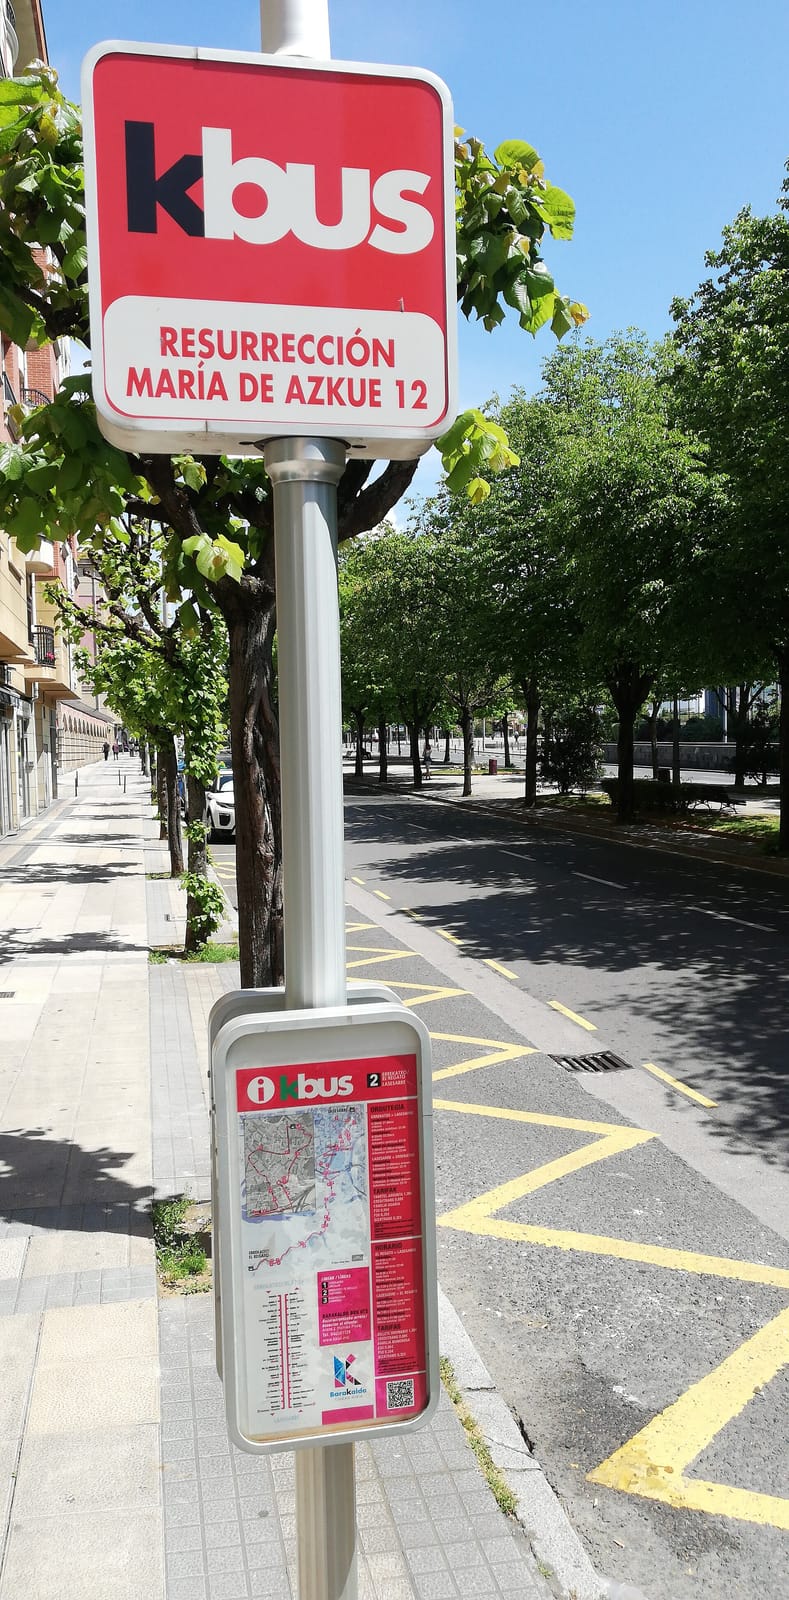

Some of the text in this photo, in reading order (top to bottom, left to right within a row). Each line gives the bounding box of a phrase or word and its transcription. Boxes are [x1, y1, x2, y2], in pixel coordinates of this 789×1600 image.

[125, 120, 434, 254] kbus
[160, 326, 395, 368] RESURRECCIÓN
[126, 362, 428, 410] MARÍA DE AZKUE 12
[280, 1074, 354, 1100] kbus
[370, 1074, 378, 1086] 2
[330, 1388, 366, 1397] Barakaldo
